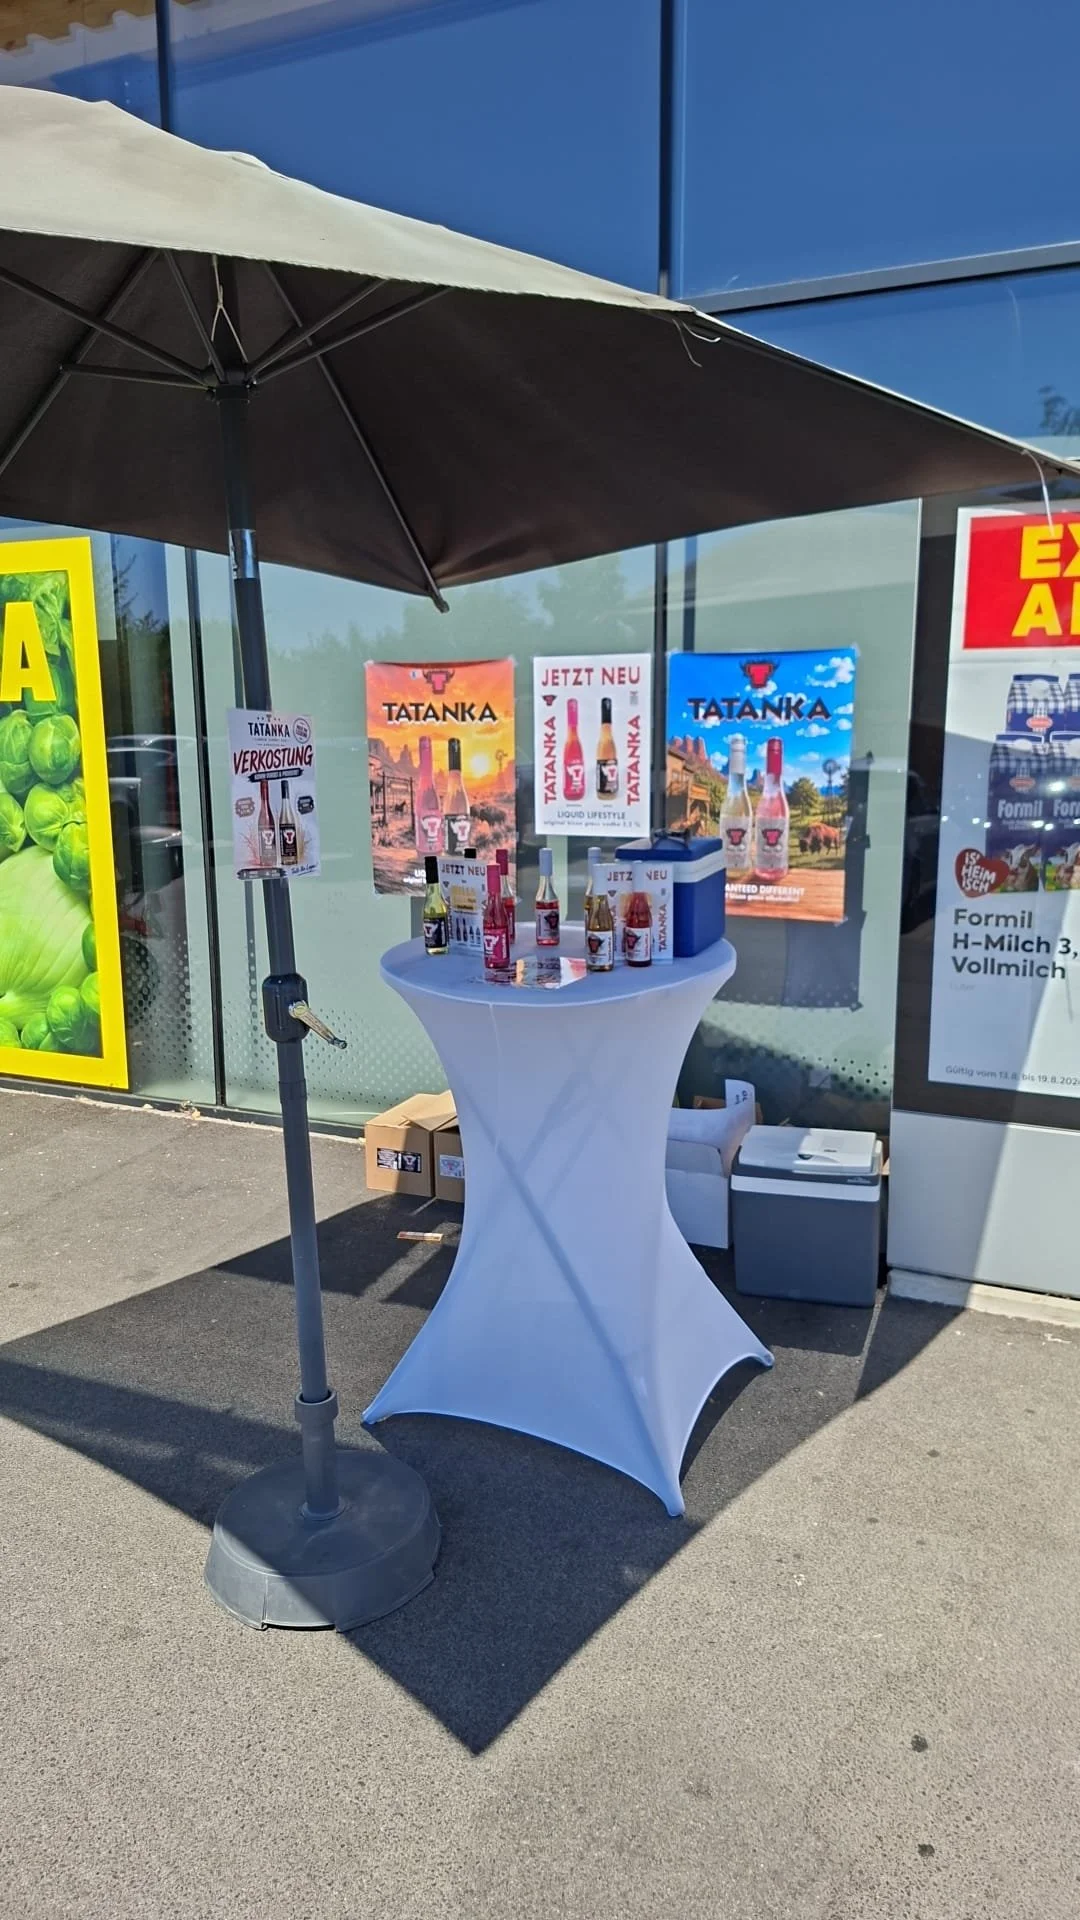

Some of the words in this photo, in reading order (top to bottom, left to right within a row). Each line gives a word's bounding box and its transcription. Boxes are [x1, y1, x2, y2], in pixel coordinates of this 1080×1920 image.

[1011, 581, 1080, 637] A
[1, 601, 57, 701] A
[541, 668, 594, 687] JETZT
[602, 666, 641, 685] NEU
[382, 701, 498, 724] TATANKA
[687, 697, 832, 721] TATANKA
[248, 722, 291, 738] TATANKA
[233, 745, 314, 776] VERKOSTUNG
[544, 716, 558, 804] TATANKA
[627, 715, 641, 806] TATANKA
[557, 810, 585, 820] LIQUID
[587, 811, 626, 820] LIFESTYLE
[997, 799, 1043, 819] Formil
[441, 864, 465, 875] JETZT
[468, 865, 486, 876] NEU
[607, 871, 633, 882] JETZ
[724, 882, 758, 893] ANTEED
[659, 903, 668, 953] TATANKA
[953, 908, 1033, 929] Formil
[952, 932, 1051, 954] H-Milch
[951, 956, 1067, 979] Vollmilch
[945, 1065, 974, 1077] Gültig
[976, 1070, 997, 1079] vom
[1022, 1072, 1035, 1082] bis
